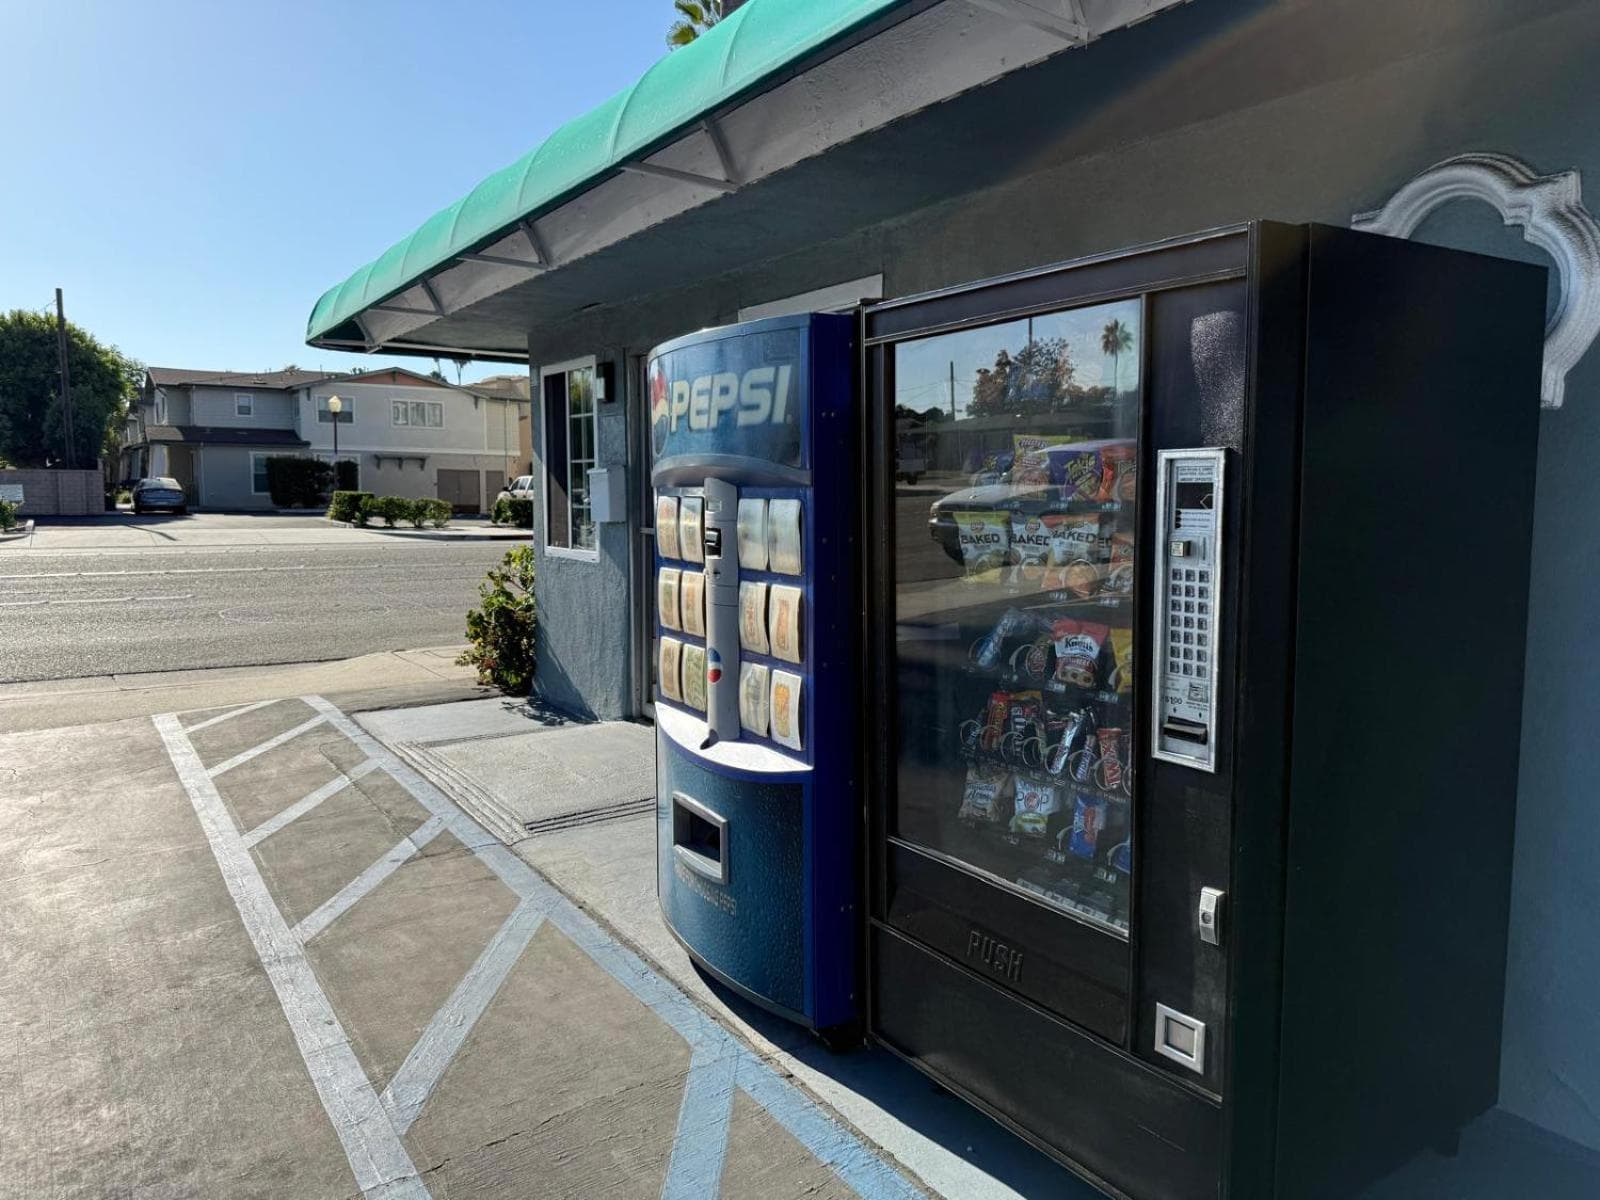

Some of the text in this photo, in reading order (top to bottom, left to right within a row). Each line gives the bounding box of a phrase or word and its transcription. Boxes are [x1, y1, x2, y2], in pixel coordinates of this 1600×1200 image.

[670, 364, 792, 433] PEPSI
[961, 533, 1000, 545] BAKED
[966, 930, 1024, 982] PUSH
